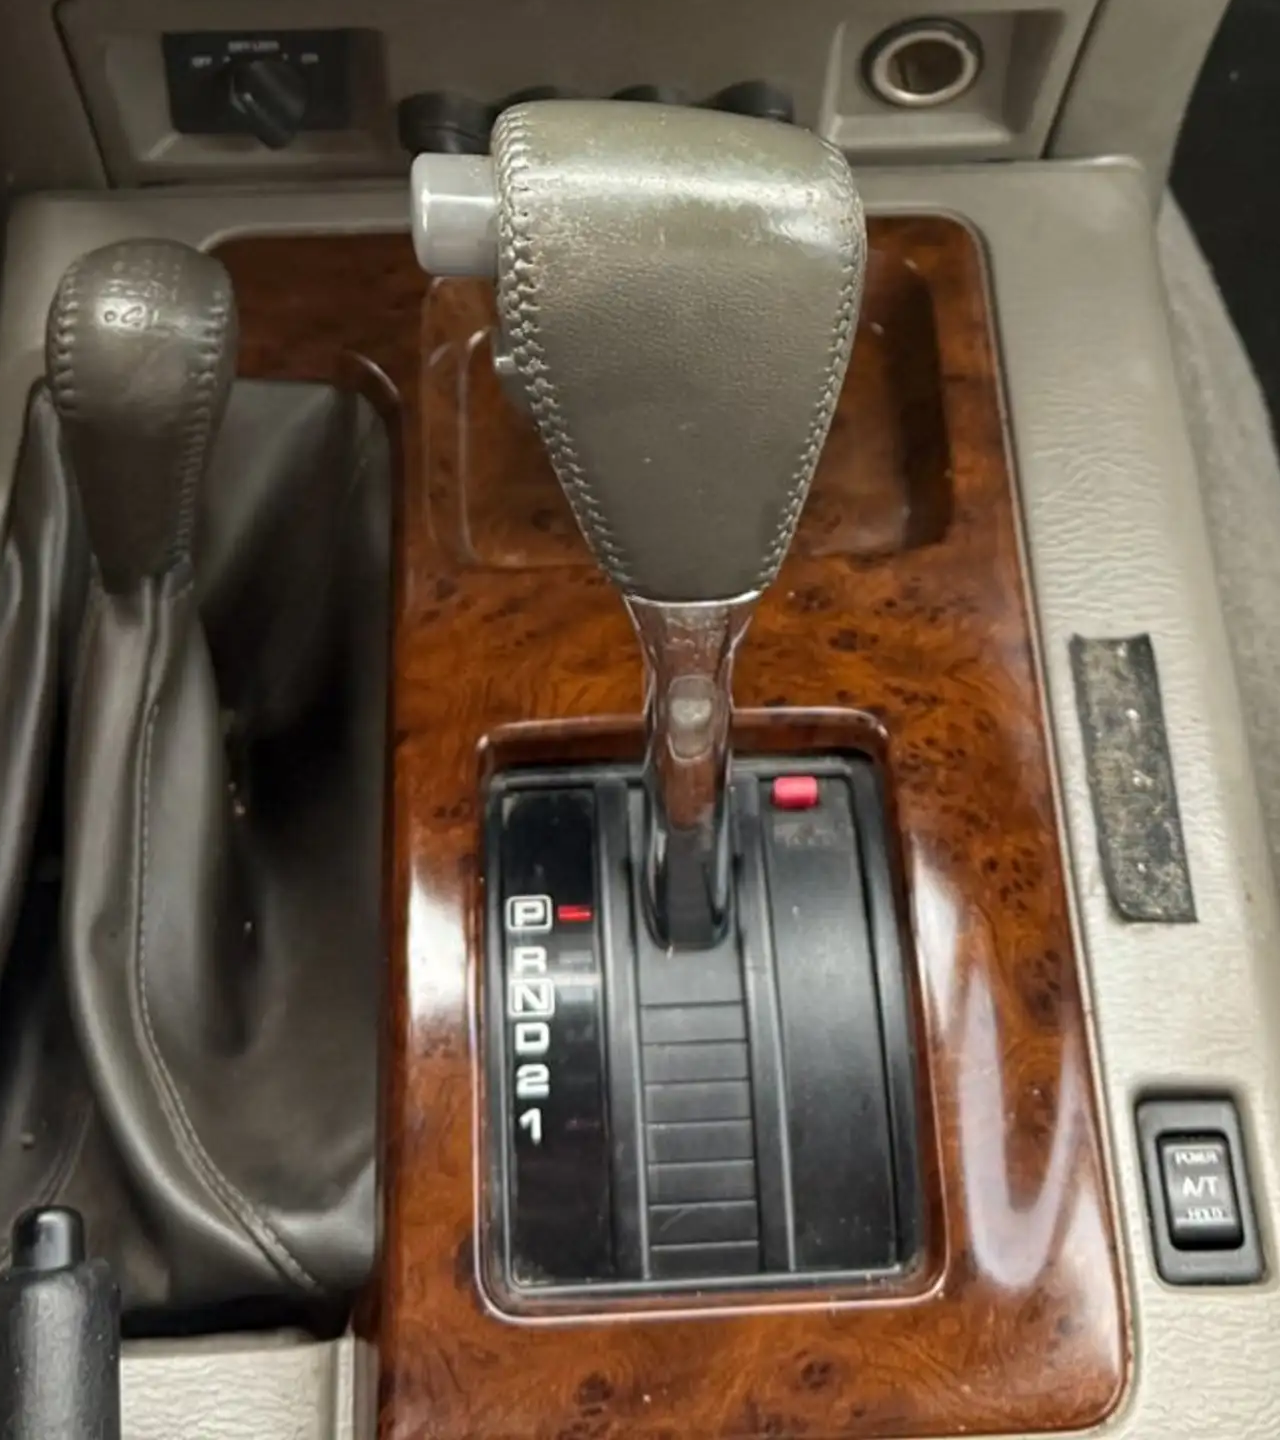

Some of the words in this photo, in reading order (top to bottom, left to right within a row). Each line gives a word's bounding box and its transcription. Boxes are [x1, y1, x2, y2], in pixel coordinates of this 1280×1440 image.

[514, 900, 545, 926] P
[514, 946, 547, 974] R
[515, 983, 549, 1013] N
[515, 1022, 550, 1055] D
[516, 1063, 550, 1099] 2
[519, 1108, 542, 1145] 1
[1182, 1175, 1218, 1198] A/T
